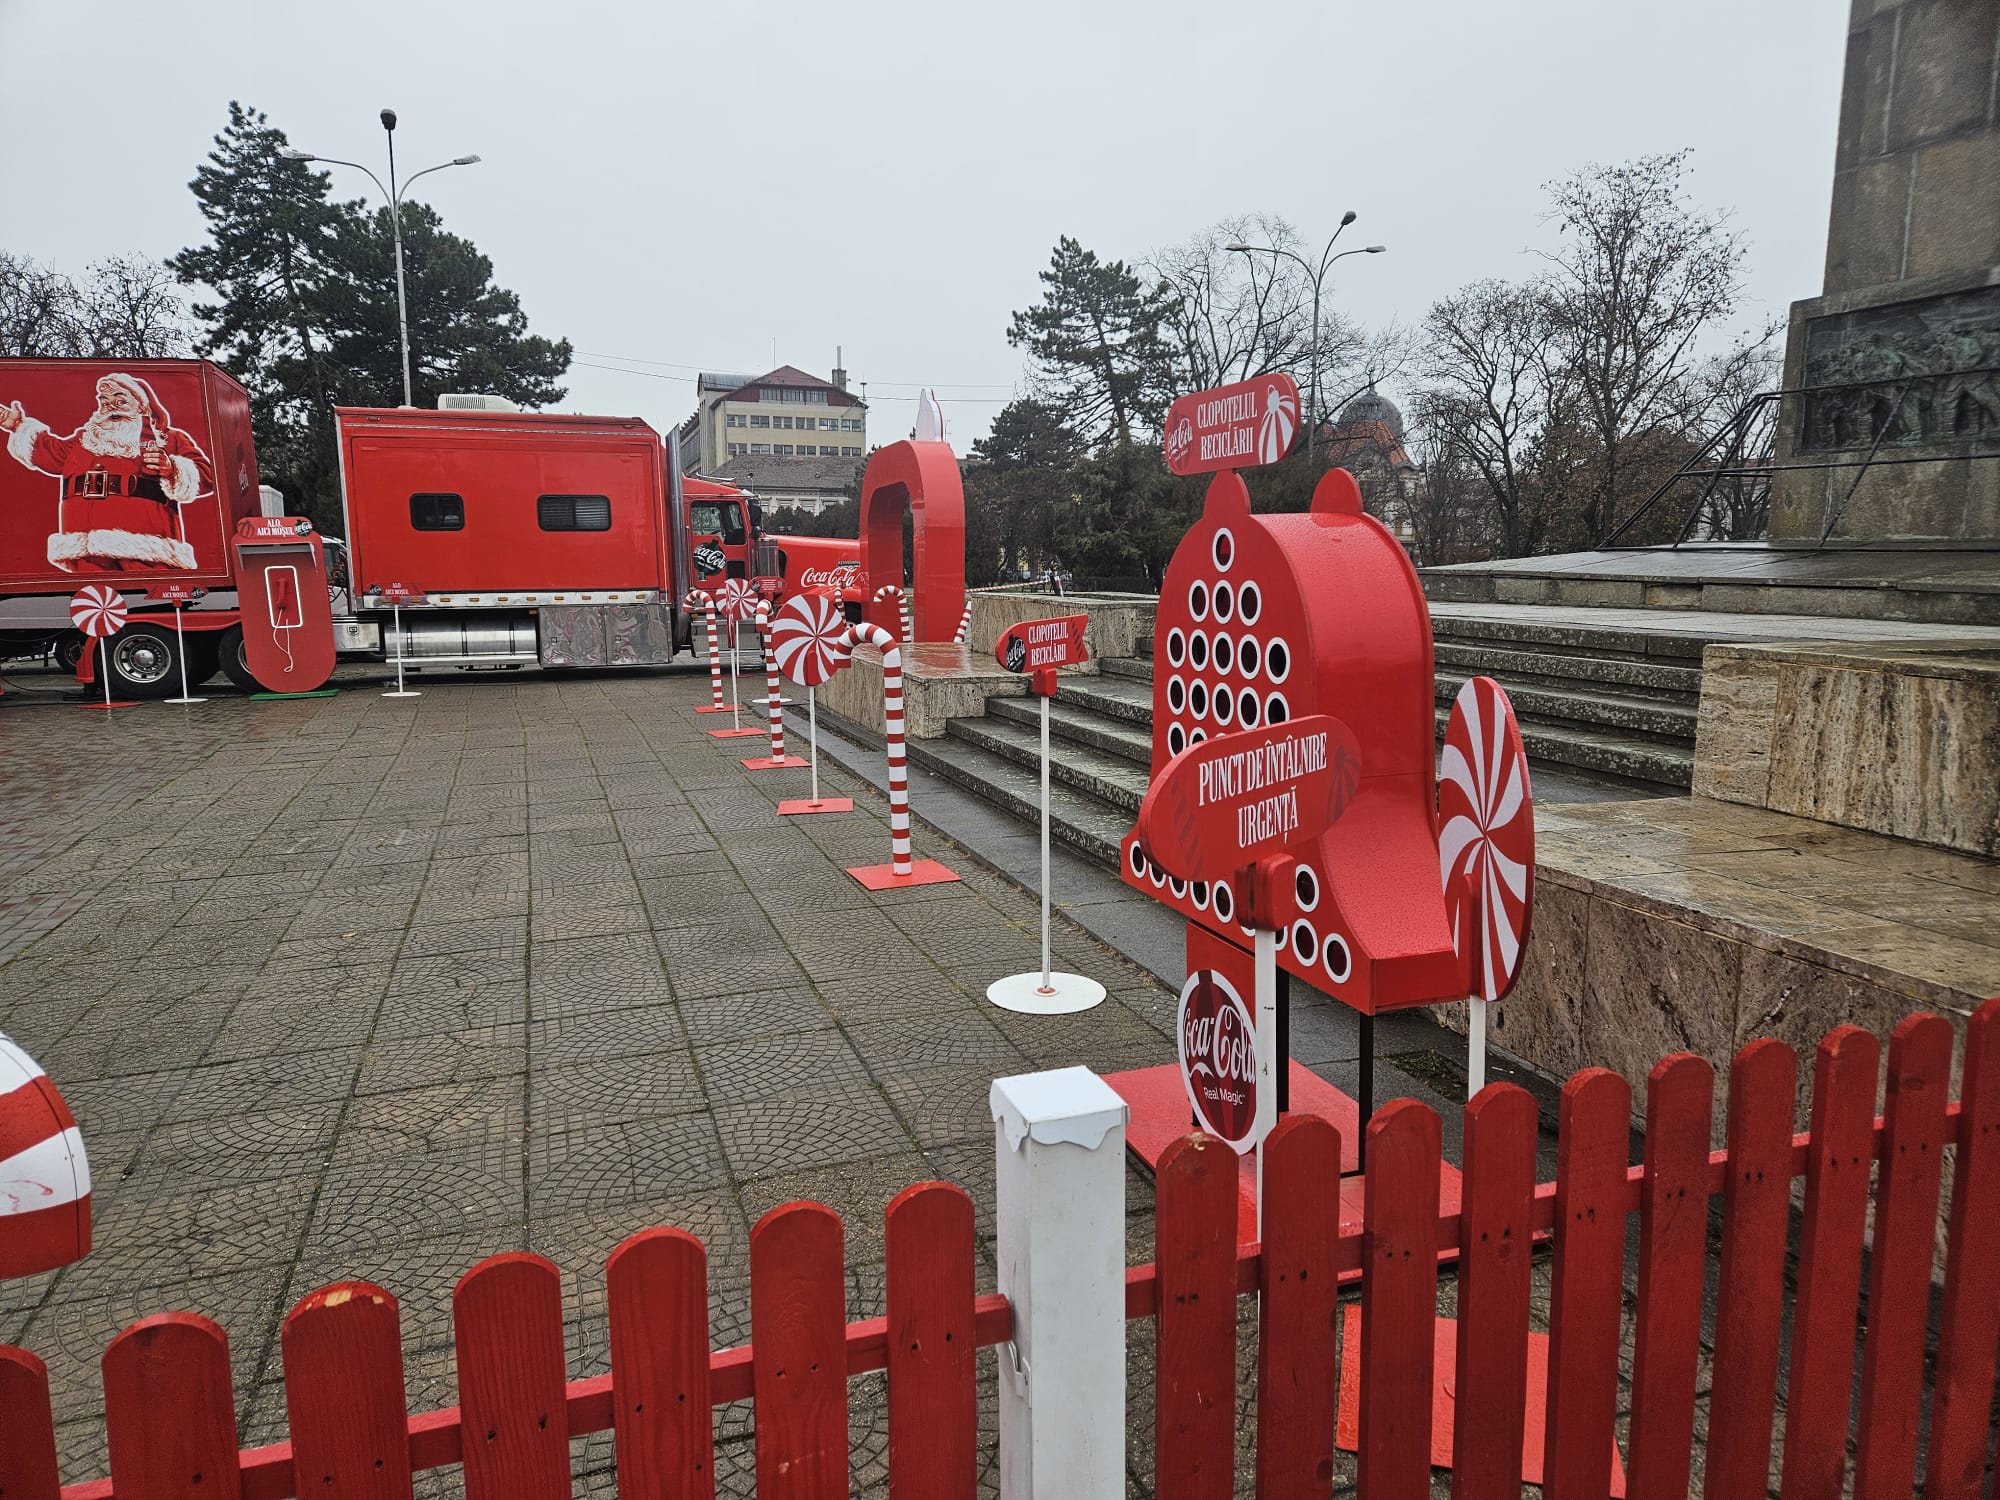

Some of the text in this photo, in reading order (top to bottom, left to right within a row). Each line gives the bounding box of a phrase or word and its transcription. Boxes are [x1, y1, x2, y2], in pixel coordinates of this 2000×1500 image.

[1197, 392, 1258, 430] CLOPOȚELUL
[1201, 426, 1254, 461] RECICLĂRII
[800, 566, 859, 588] Coca-Cola
[1028, 622, 1068, 645] CLOPOȚELUL
[1198, 732, 1327, 807] PUNCT DE ÎNTÂLNIRE
[1237, 785, 1299, 848] URGENȚĂ
[1203, 1087, 1219, 1101] Real
